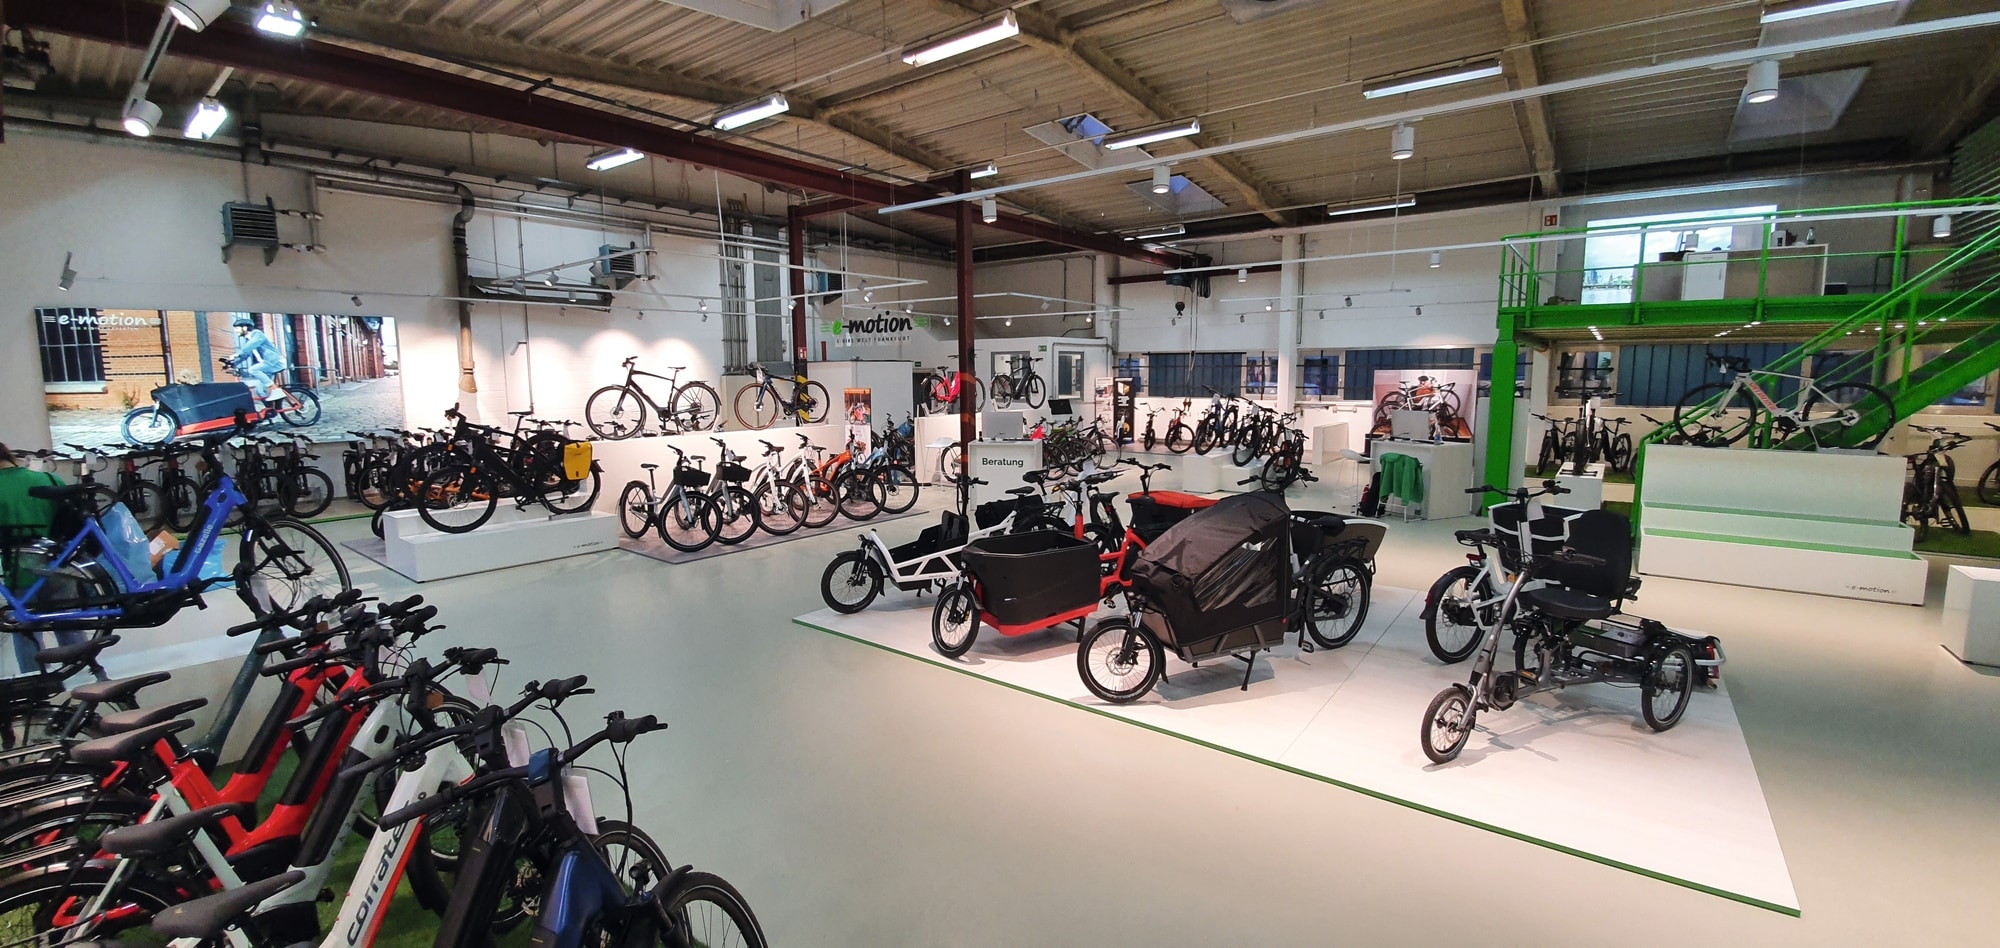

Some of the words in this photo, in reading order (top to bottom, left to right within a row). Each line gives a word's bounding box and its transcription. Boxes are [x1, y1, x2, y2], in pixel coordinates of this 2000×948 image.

[59, 312, 147, 326] e-motion
[832, 310, 912, 335] e-motion
[982, 457, 1024, 468] Beratung
[347, 799, 411, 947] corrate
